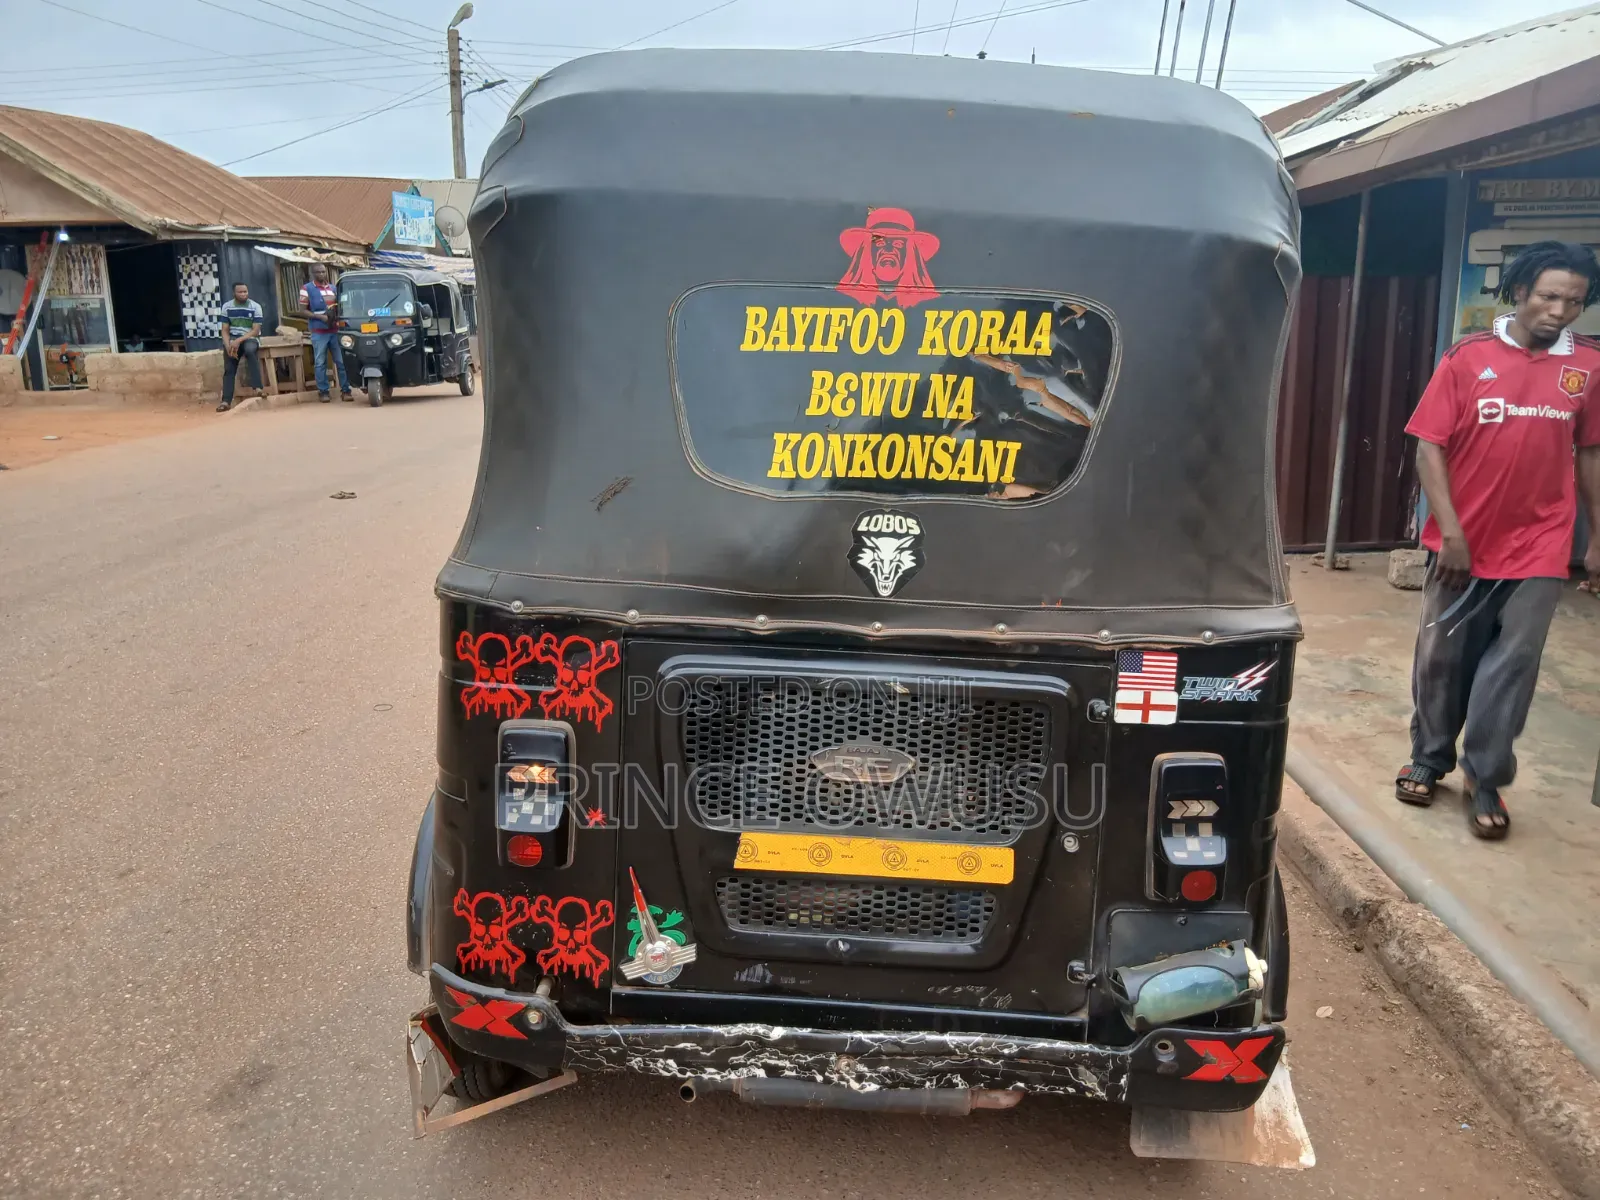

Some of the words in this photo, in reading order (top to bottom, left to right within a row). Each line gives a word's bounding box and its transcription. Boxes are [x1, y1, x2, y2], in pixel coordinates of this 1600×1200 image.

[917, 309, 1053, 357] KORAA
[922, 373, 976, 420] NA
[767, 432, 1022, 483] KONKONSANI
[857, 514, 920, 535] LOBOS
[1179, 688, 1262, 701] SPARK
[1182, 676, 1239, 689] TWIN
